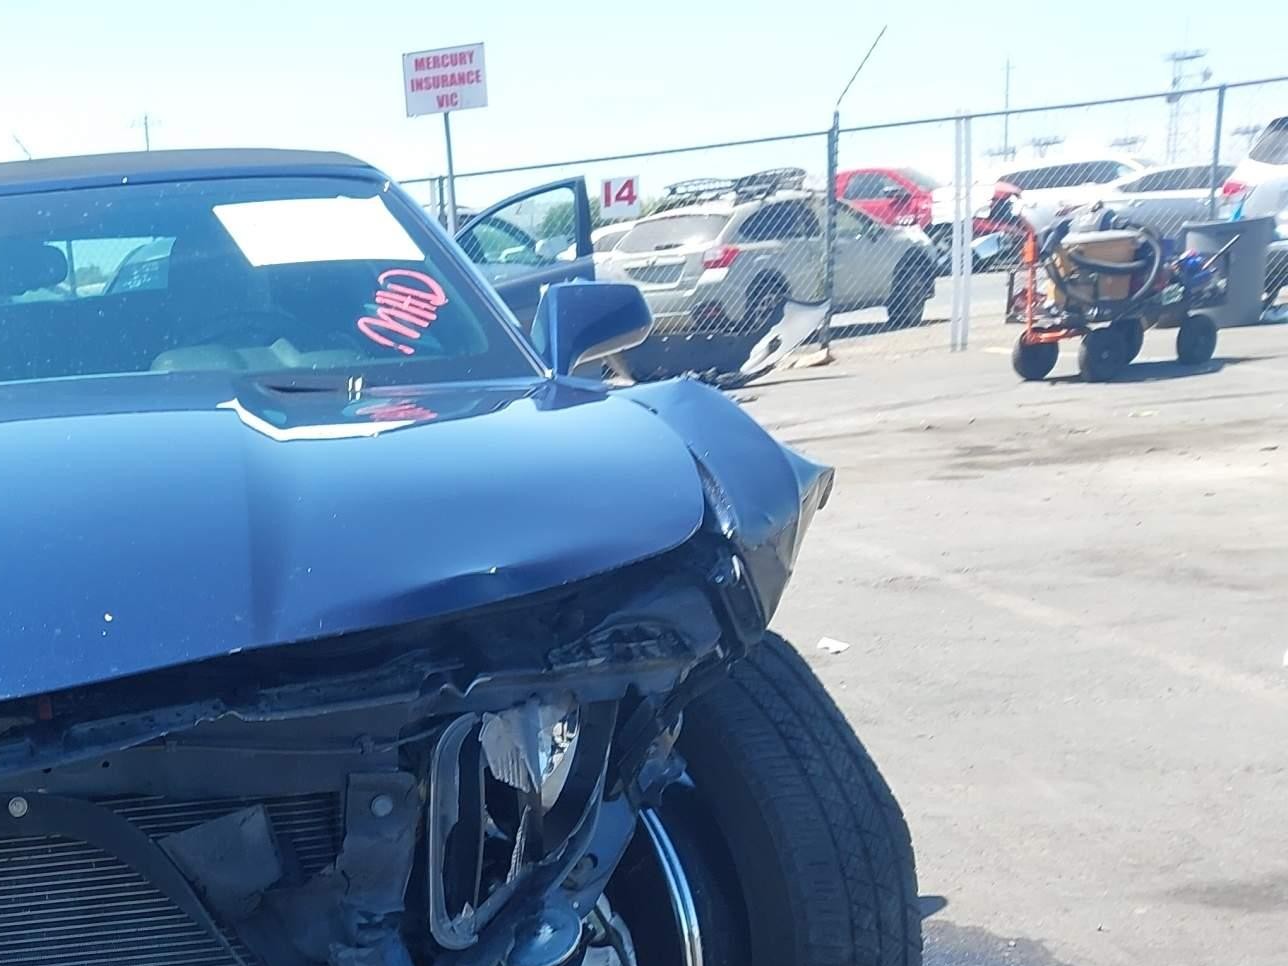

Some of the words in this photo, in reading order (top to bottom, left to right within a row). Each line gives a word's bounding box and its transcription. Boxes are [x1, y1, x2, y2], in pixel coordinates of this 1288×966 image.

[414, 50, 474, 72] MERCURY
[410, 69, 482, 92] INSURANCE
[436, 92, 459, 109] VIC
[603, 179, 637, 207] 14
